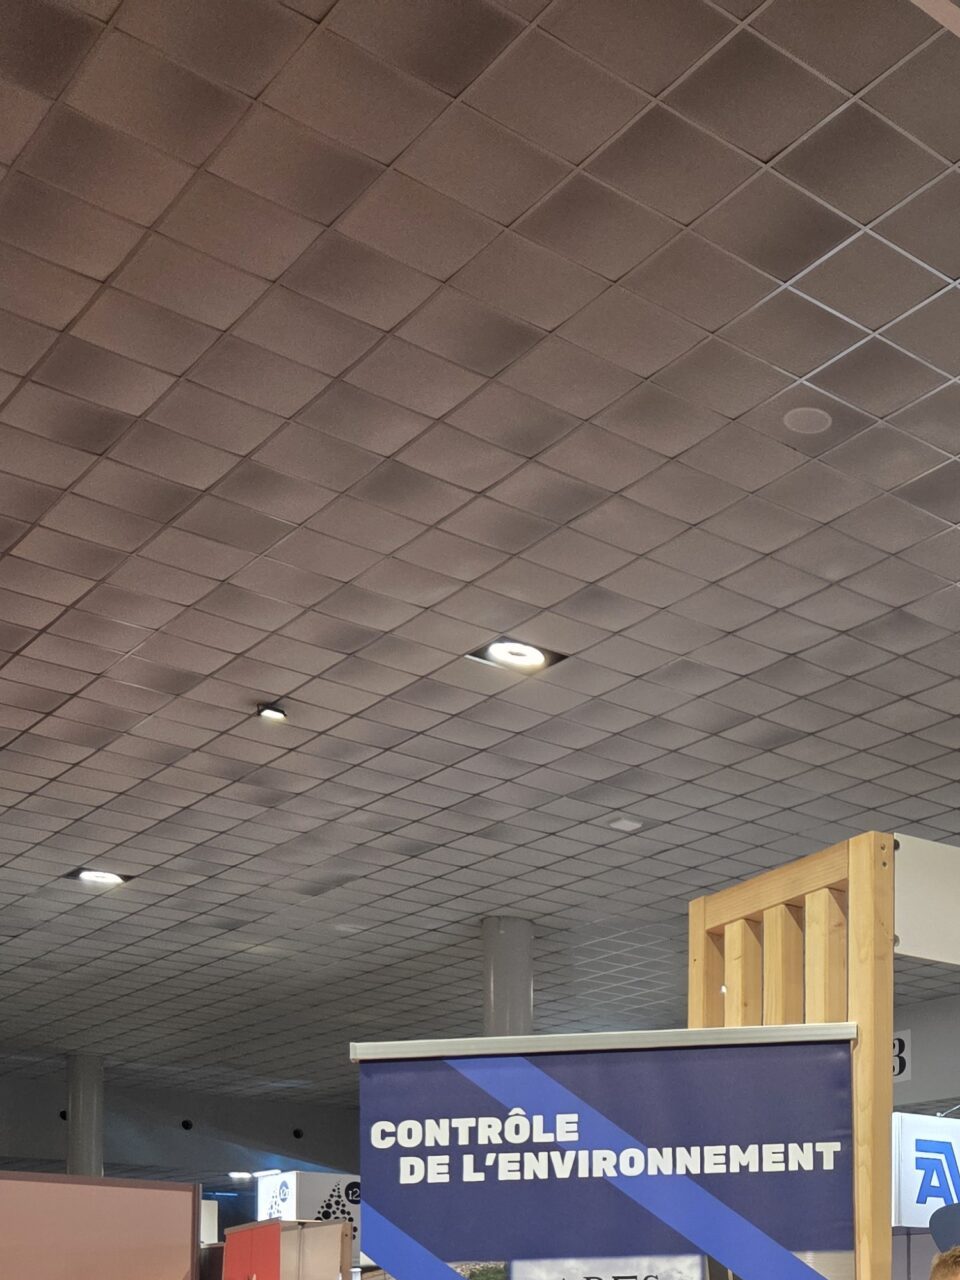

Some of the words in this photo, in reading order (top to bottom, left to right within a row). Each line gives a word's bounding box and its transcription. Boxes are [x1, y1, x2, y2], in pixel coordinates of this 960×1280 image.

[370, 1106, 581, 1150] CONTRÔLE
[398, 1154, 451, 1185] DE
[462, 1141, 842, 1183] L'ENVIRONNEMENT
